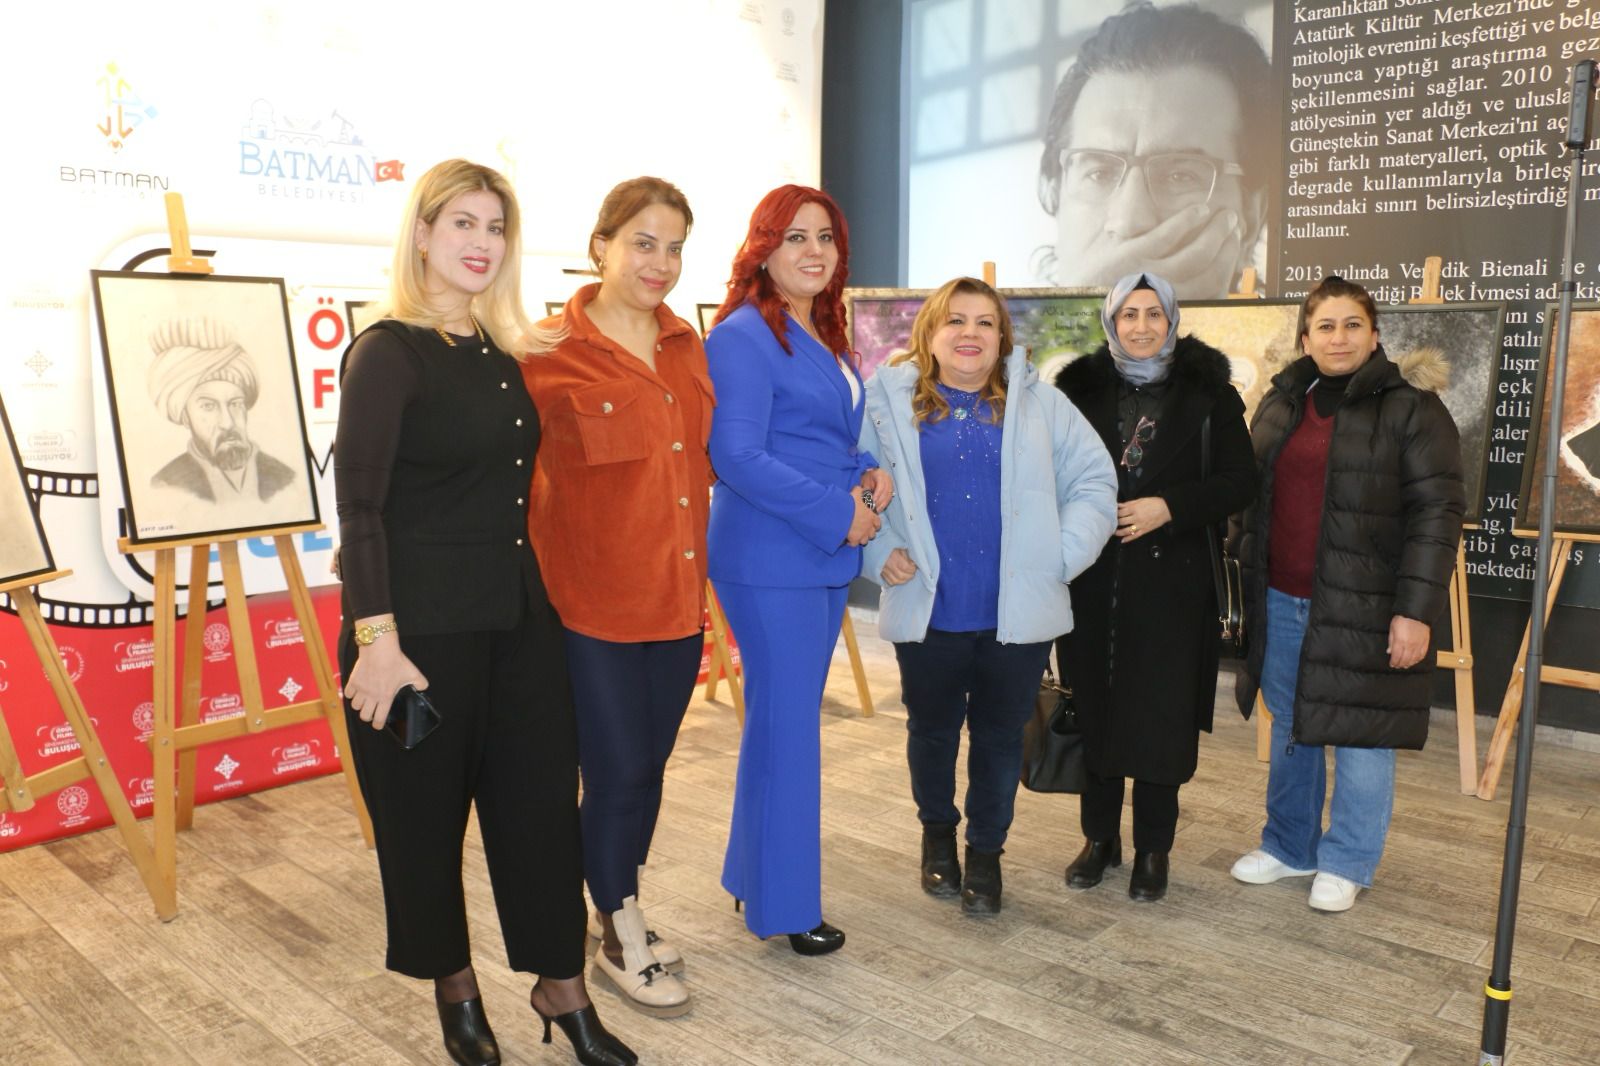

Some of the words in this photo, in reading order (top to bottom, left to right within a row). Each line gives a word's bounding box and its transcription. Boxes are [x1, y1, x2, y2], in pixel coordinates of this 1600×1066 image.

[1294, 0, 1388, 23] Karanlıktan
[1293, 22, 1355, 45] Atatürk
[1365, 14, 1423, 35] Kültür
[1293, 43, 1365, 67] mitolojik
[1367, 32, 1437, 57] evrenini
[1440, 18, 1527, 48] keşfettiği
[1532, 19, 1555, 34] ve
[1292, 69, 1364, 90] boyunca
[1374, 58, 1439, 83] yaptığı
[1451, 45, 1547, 69] araştırma
[1291, 81, 1415, 113] şekillenmesini
[1426, 75, 1488, 97] sağlar.
[1501, 64, 1552, 88] 2010
[1290, 110, 1377, 133] atölyesinin
[1385, 108, 1414, 127] yer
[1422, 100, 1471, 120] aldığı
[1482, 99, 1504, 113] ve
[1290, 131, 1379, 153] Güneştekin
[1386, 127, 1434, 145] Sanat
[1440, 114, 1538, 141] Merkezi'ni
[239, 140, 378, 186] BATMAN
[1288, 157, 1318, 178] gibi
[1328, 154, 1370, 172] farklı
[1379, 144, 1488, 169] materyalleri,
[1498, 138, 1548, 162] optik
[60, 166, 169, 191] BATMAN
[1288, 177, 1353, 199] degrade
[1363, 166, 1502, 191] kullanımlarıyla
[1287, 198, 1367, 217] arasındaki
[1375, 199, 1417, 213] sınırı
[1426, 186, 1568, 210] belirsizleştirdiğ
[1286, 222, 1349, 239] kullanır.
[1285, 266, 1322, 281] 2013
[1333, 264, 1389, 280] yılında
[1481, 258, 1548, 277] Bienali
